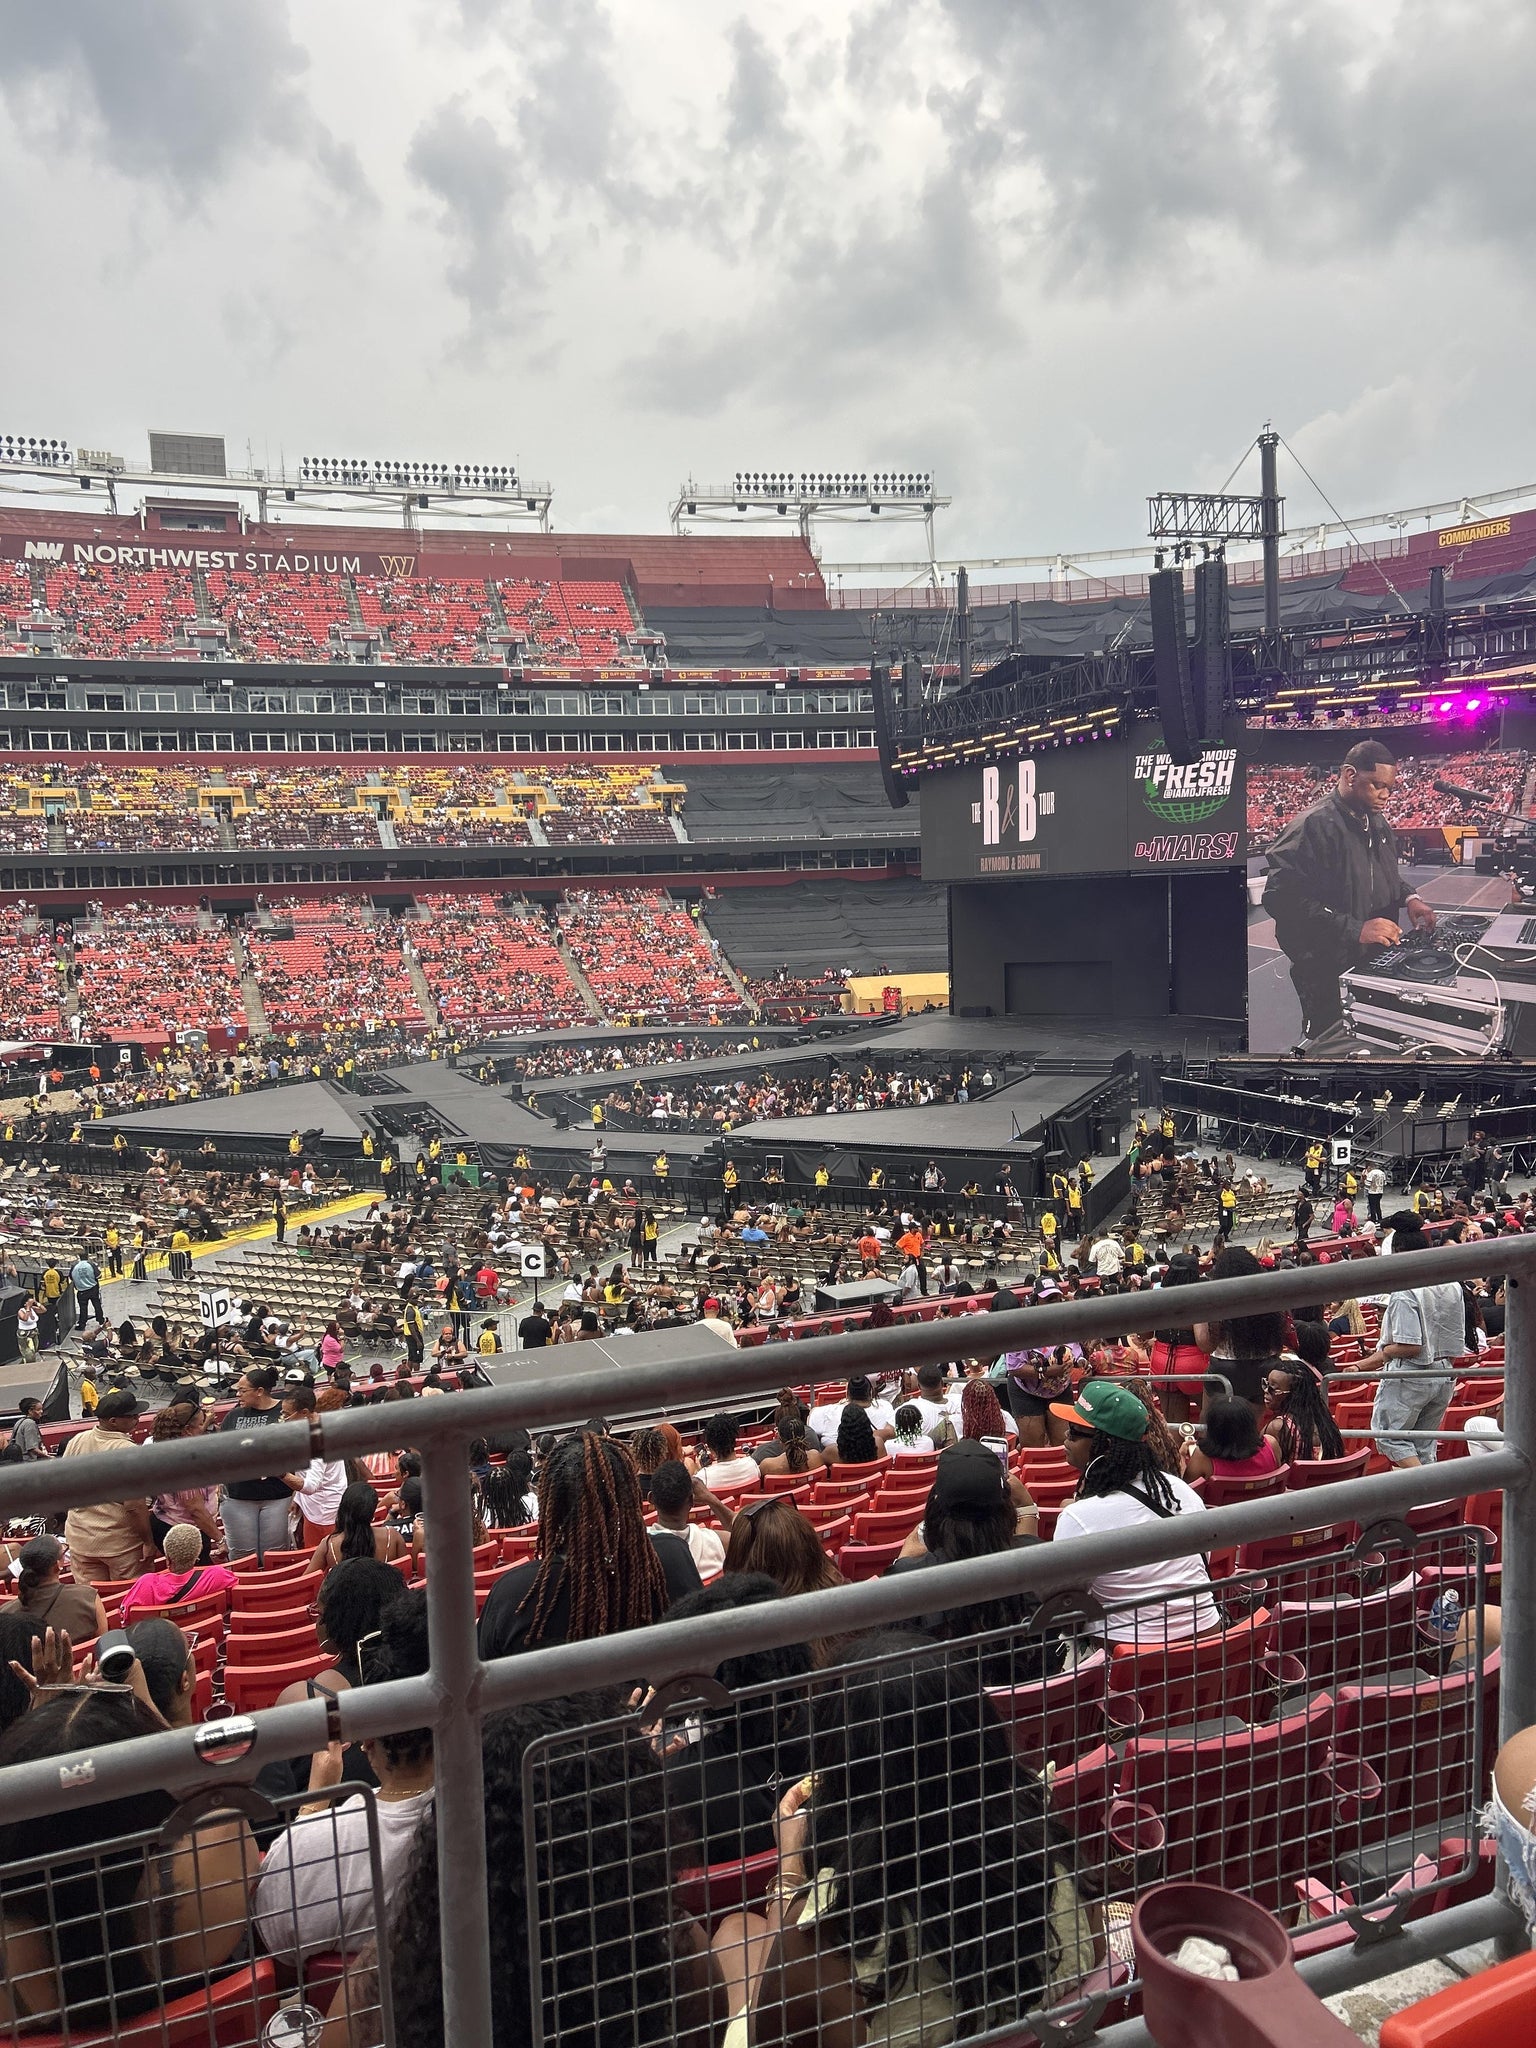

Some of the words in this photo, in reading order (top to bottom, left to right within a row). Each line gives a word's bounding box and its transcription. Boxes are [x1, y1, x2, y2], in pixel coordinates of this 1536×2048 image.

[1439, 521, 1510, 546] COMMANDERS
[24, 541, 64, 560] NW
[73, 544, 238, 569] NORTHWEST
[245, 553, 361, 573] STADIUM
[816, 670, 824, 678] 35
[1135, 754, 1154, 766] THE
[1198, 749, 1237, 763] AMOUS
[1134, 766, 1152, 779] DJ
[1152, 760, 1235, 790] FRESH
[1163, 786, 1231, 799] @IAMDJFRESH
[971, 802, 981, 824] THE
[1039, 792, 1055, 815] TOUR
[1134, 842, 1155, 857] DJ
[1149, 832, 1239, 862] MARS!
[980, 856, 1010, 872] RAYMOND
[1011, 857, 1016, 870] &
[1017, 853, 1041, 870] BROWN
[1337, 1147, 1348, 1159] B
[524, 1254, 541, 1270] C
[201, 1300, 211, 1318] D
[215, 1299, 228, 1318] D
[236, 1415, 269, 1424] CHRIS
